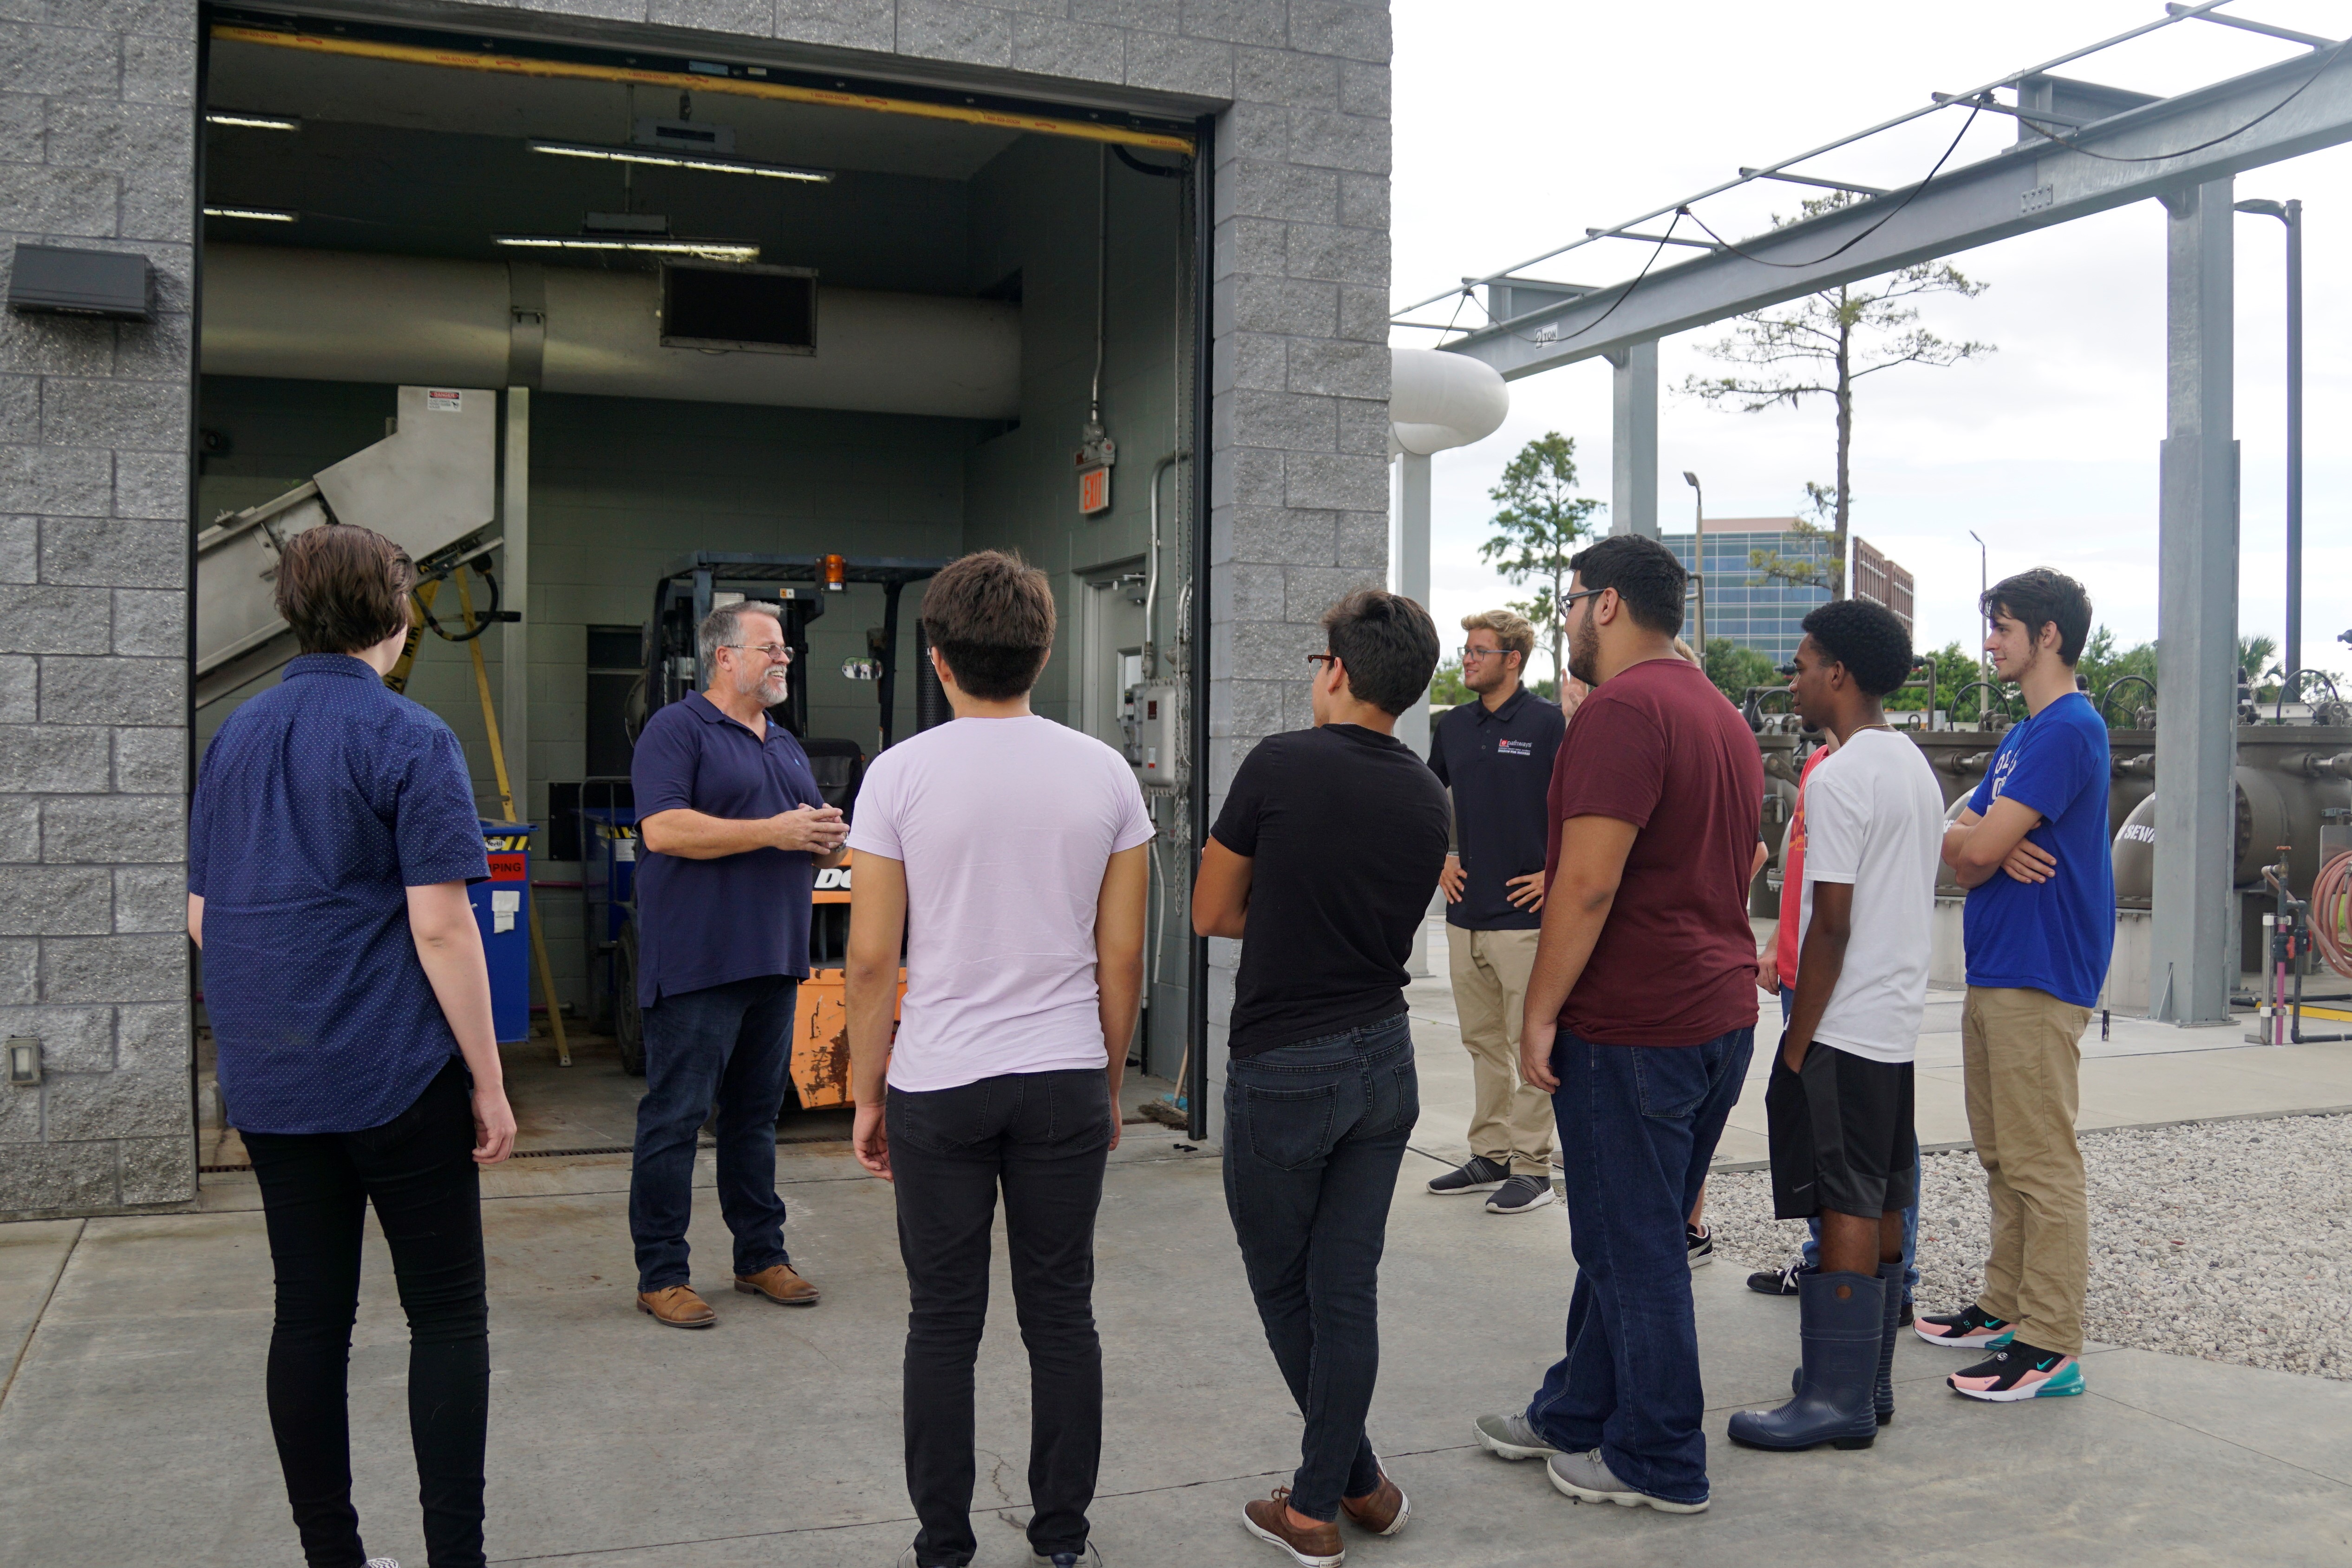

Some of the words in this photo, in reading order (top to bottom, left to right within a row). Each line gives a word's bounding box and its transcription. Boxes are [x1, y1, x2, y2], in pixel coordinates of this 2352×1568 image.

[1535, 331, 1542, 347] 2
[1543, 329, 1556, 341] TON
[1084, 471, 1102, 510] EXIT
[489, 862, 521, 872] PING
